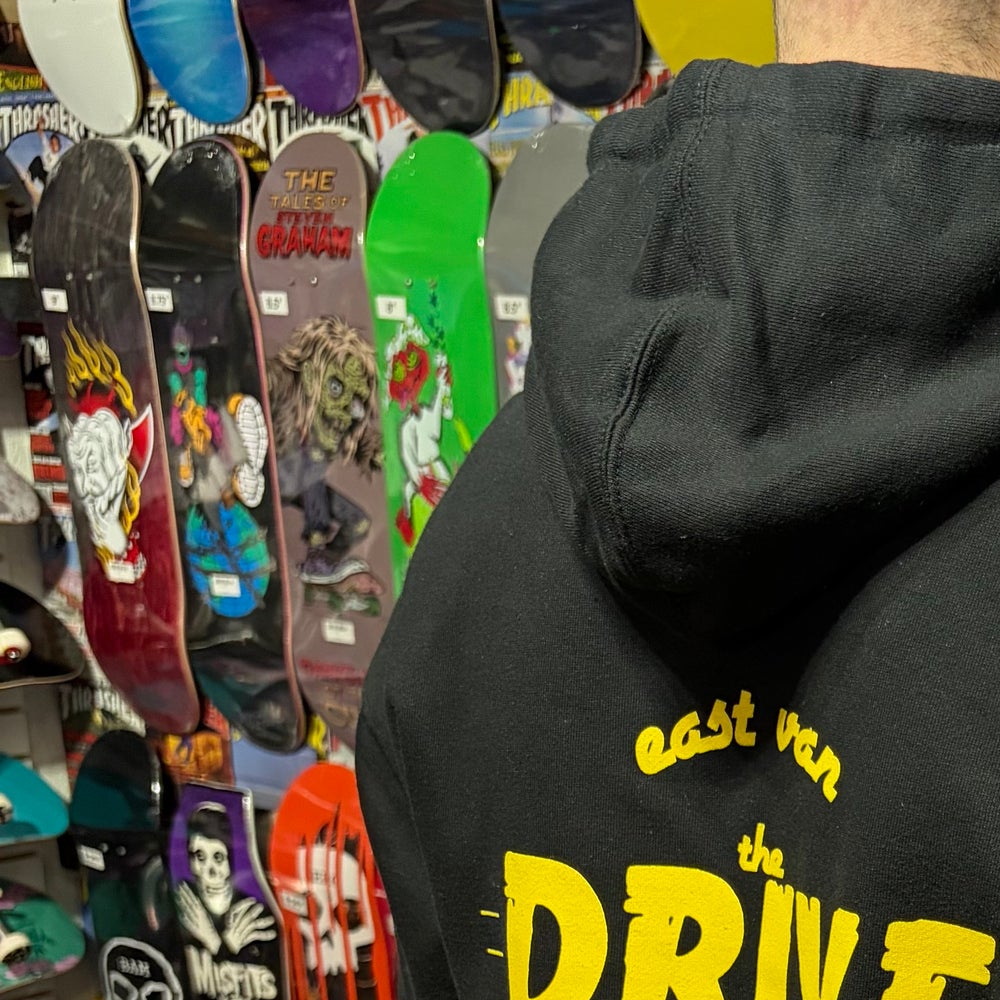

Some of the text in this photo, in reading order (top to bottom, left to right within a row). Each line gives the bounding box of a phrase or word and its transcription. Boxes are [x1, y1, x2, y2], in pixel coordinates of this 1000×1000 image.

[270, 194, 348, 210] TALES OF
[284, 169, 336, 192] THE
[256, 224, 352, 260] GRAHAM
[635, 690, 841, 802] east van
[738, 823, 784, 879] the
[186, 944, 277, 1000] MISFITS
